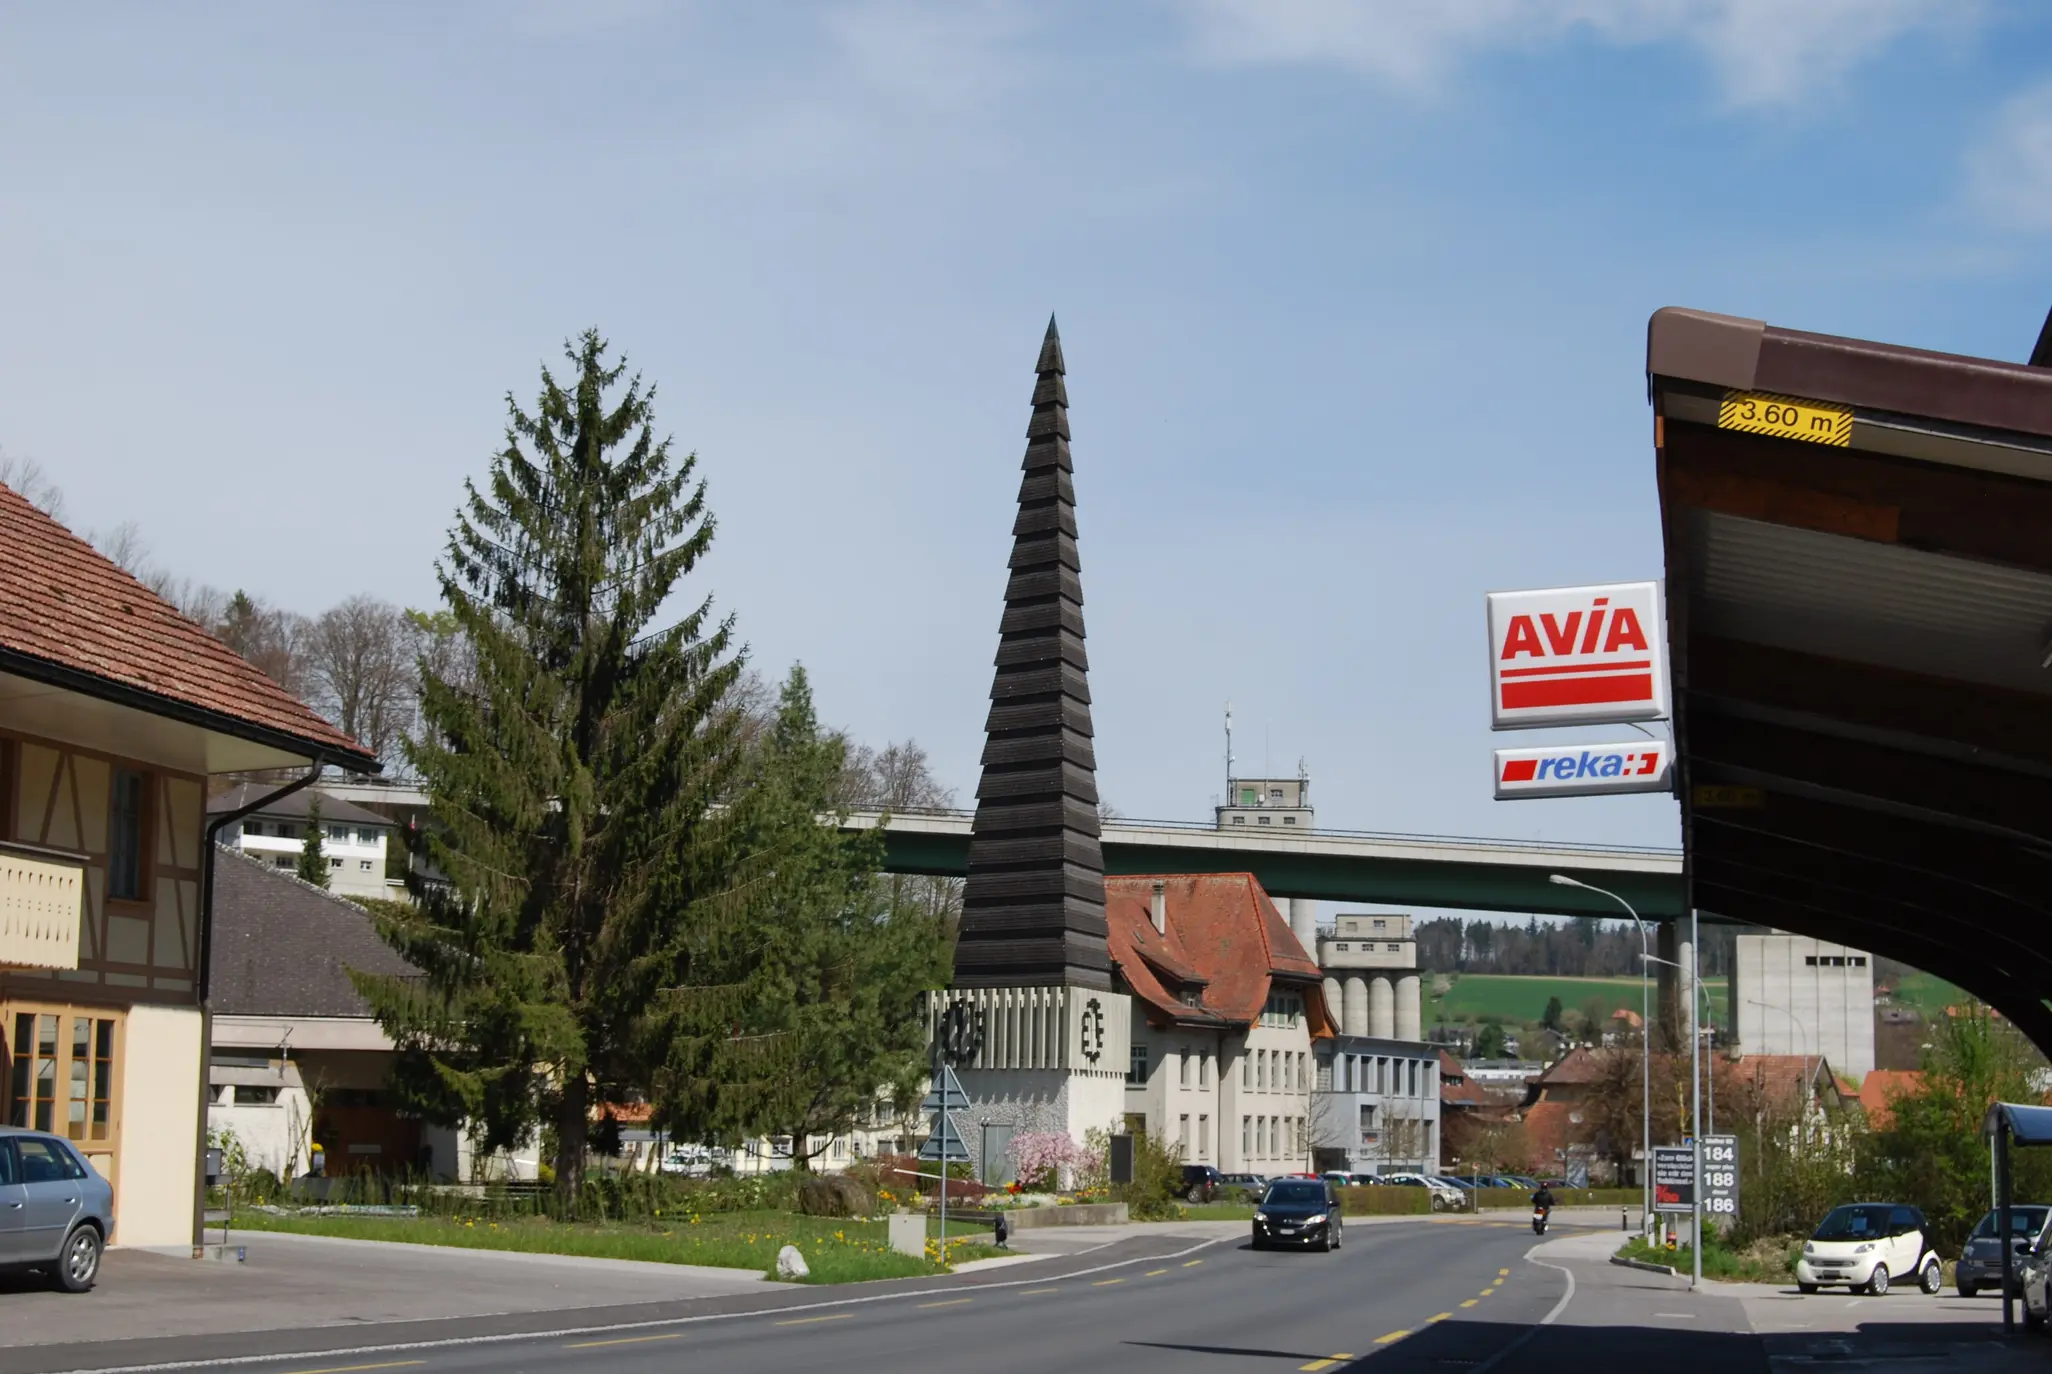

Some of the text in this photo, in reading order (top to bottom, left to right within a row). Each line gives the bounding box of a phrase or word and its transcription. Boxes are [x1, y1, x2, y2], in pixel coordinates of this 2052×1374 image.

[1740, 400, 1833, 432] 3.60 m
[1703, 1147, 1734, 1161] 184
[1703, 1172, 1734, 1187] 188
[1703, 1197, 1735, 1212] 186
